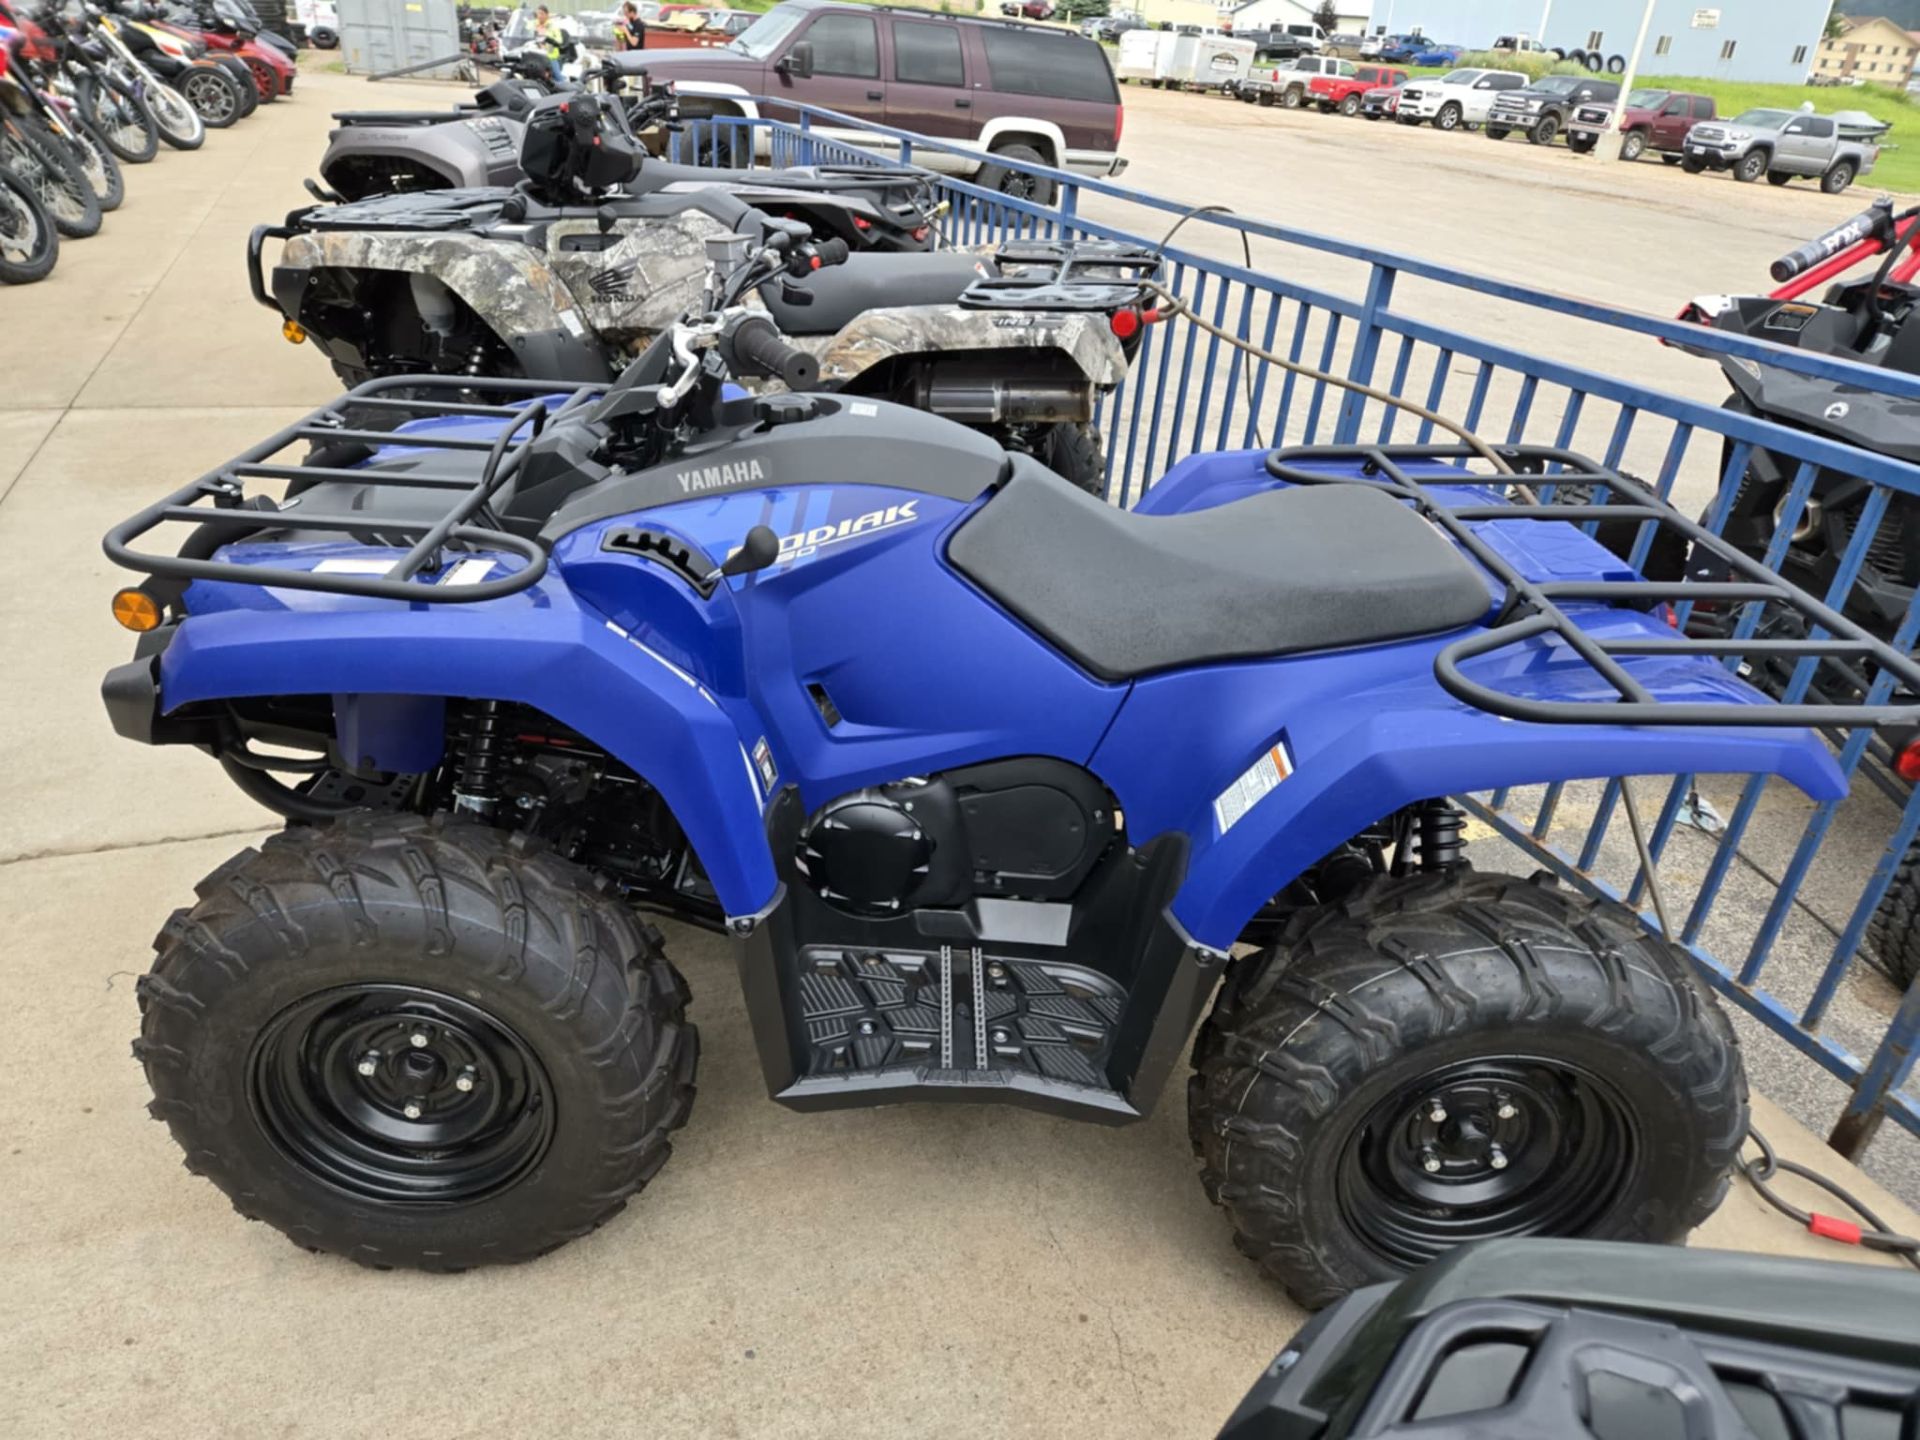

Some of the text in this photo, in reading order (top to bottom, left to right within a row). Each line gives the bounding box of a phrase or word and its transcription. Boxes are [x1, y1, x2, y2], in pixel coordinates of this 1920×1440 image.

[590, 294, 645, 304] HONDA
[677, 459, 764, 493] YAMAHA
[727, 499, 919, 563] ODIAK
